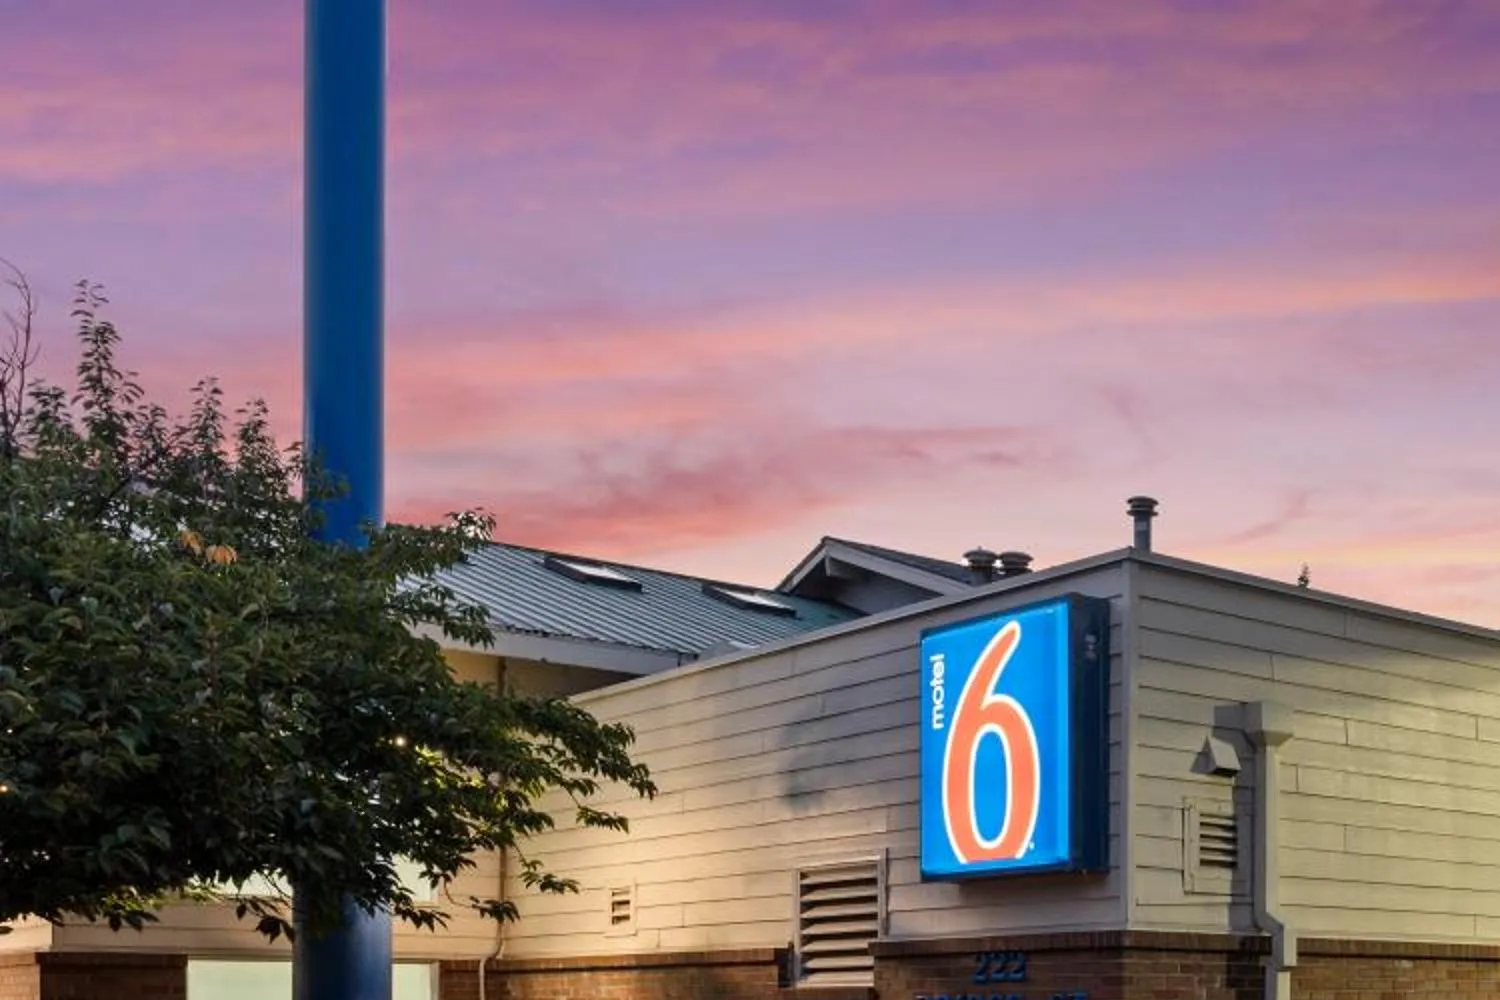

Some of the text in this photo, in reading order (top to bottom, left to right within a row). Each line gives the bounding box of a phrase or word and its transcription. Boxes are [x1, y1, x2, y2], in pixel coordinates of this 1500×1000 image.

[930, 619, 1041, 865] motel 6
[973, 950, 1027, 984] 222
